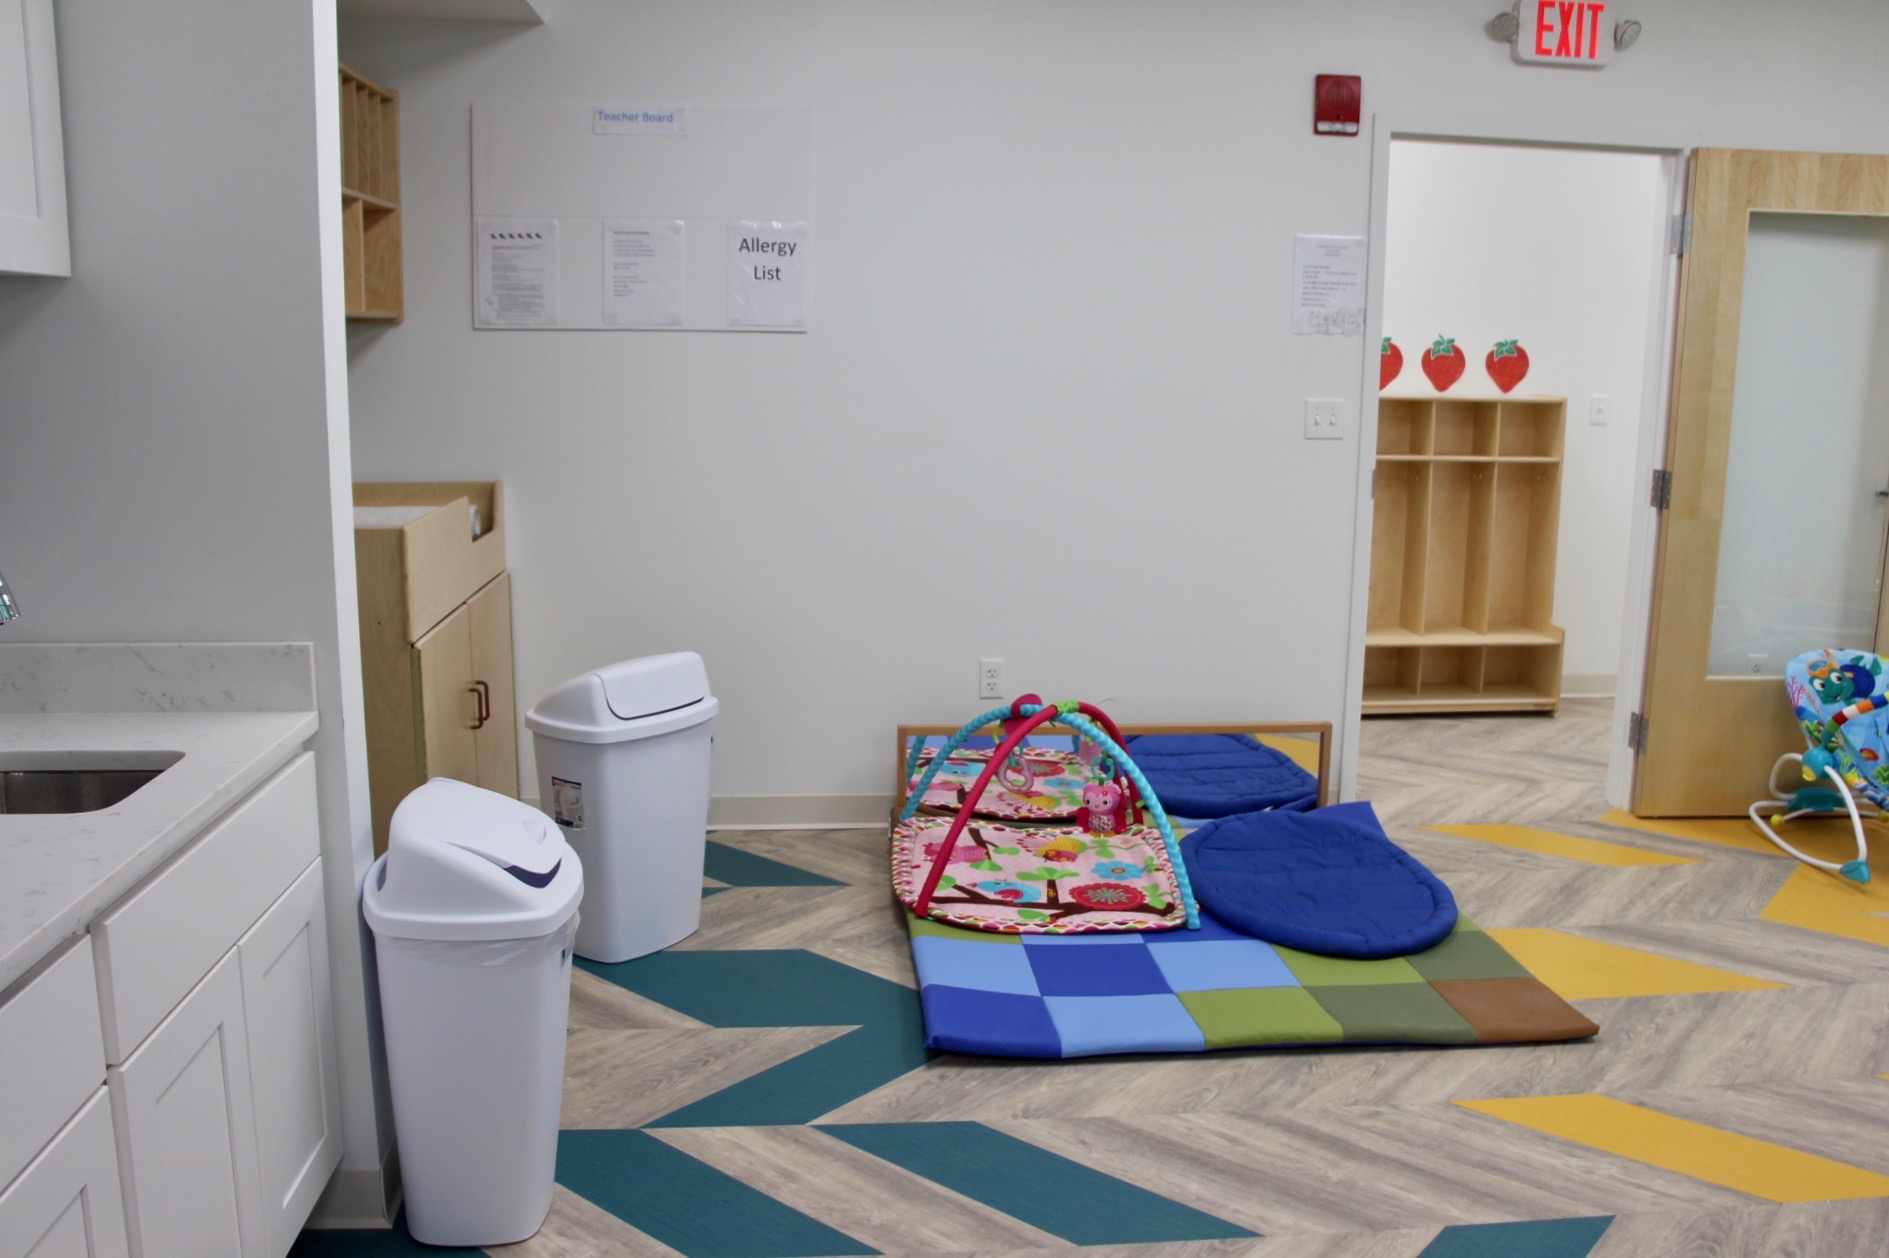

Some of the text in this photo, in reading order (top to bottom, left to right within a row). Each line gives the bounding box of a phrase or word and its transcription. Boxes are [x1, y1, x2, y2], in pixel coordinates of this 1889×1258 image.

[1535, 0, 1605, 59] EXIT
[597, 110, 674, 123] Teacher Board
[738, 237, 797, 257] Allergy
[754, 265, 782, 281] List
